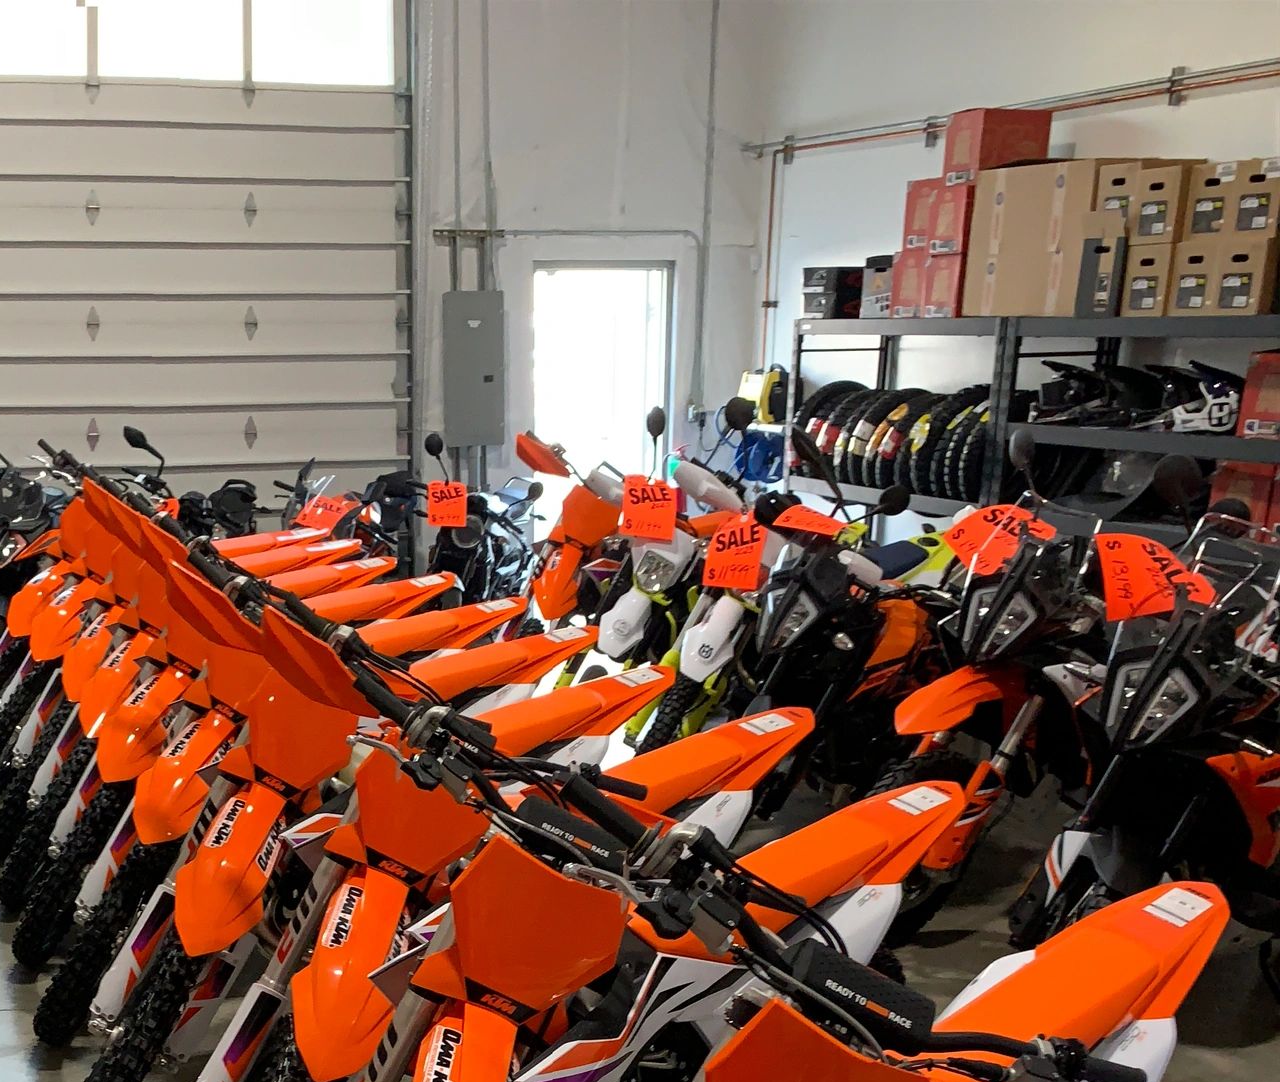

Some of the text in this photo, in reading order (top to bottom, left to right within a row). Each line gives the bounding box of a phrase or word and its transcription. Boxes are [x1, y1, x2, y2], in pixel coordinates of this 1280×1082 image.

[432, 487, 464, 504] SALE
[629, 487, 672, 505] SALE
[715, 524, 762, 553] SALE
[541, 822, 610, 858] READY TO RACE
[480, 993, 518, 1015] KTM
[824, 978, 913, 1029] READY TO RACE
